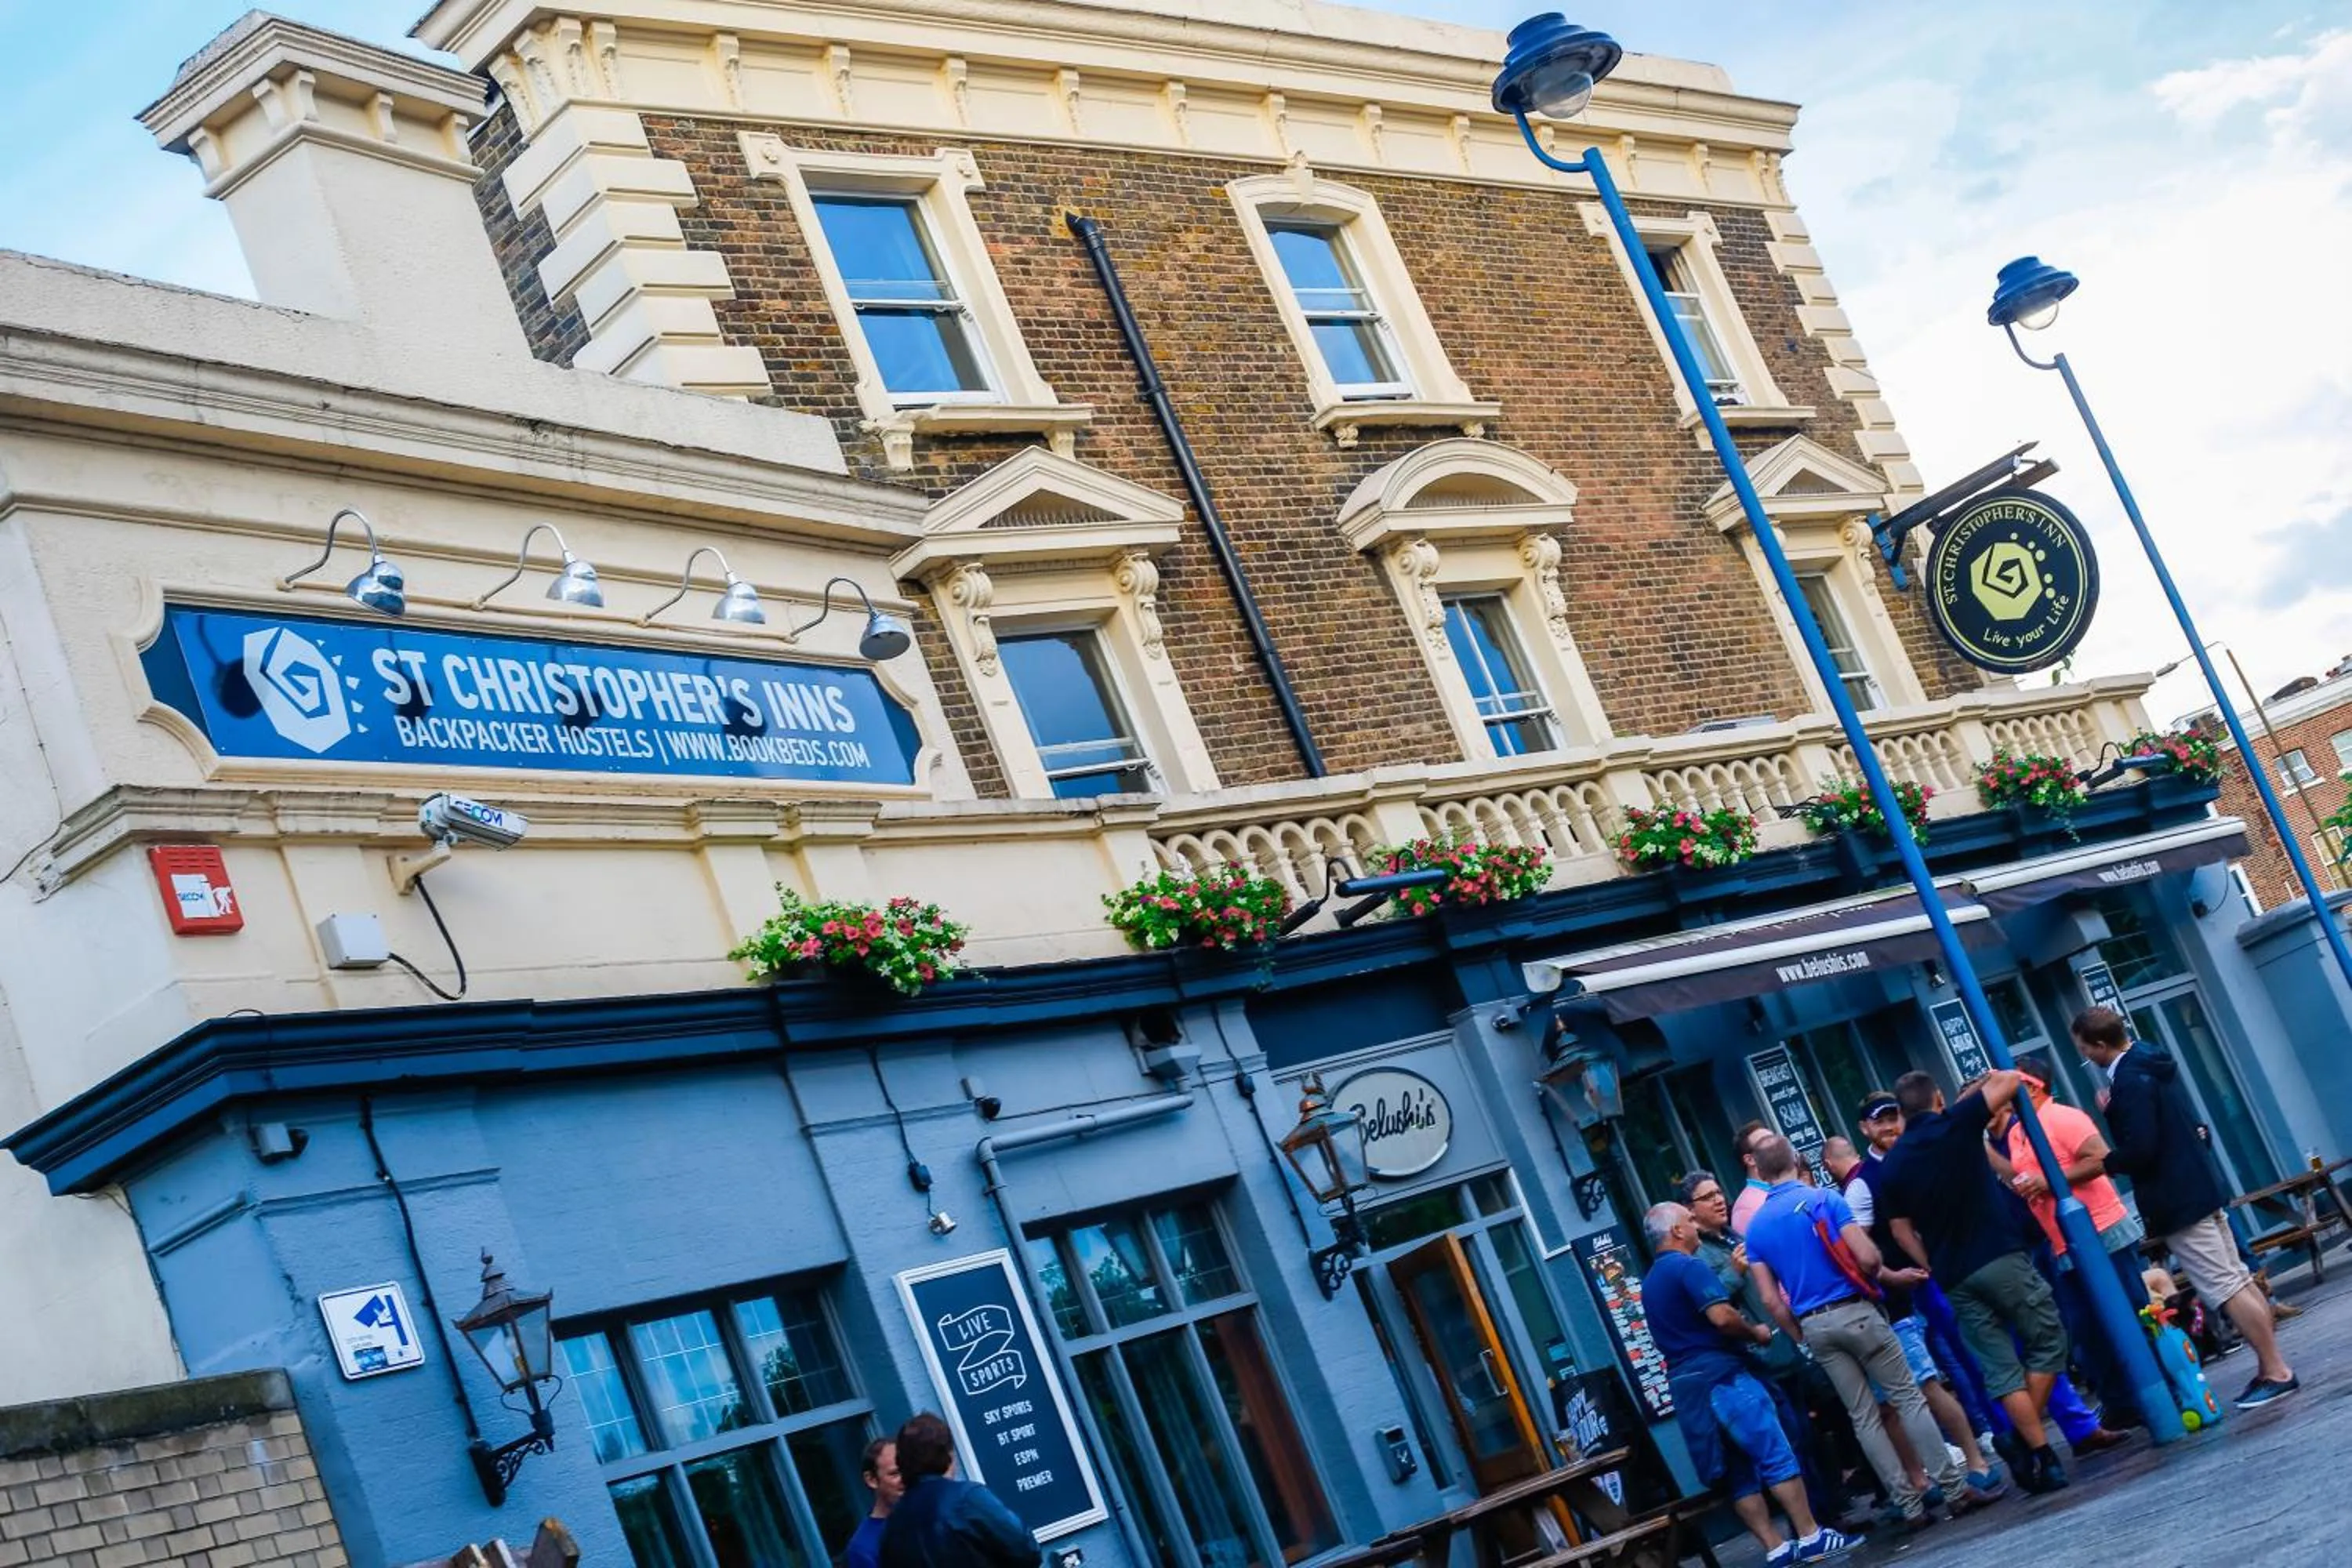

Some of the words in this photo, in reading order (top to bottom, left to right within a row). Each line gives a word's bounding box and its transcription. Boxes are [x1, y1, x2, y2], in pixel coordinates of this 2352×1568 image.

[1942, 506, 2038, 581] CHRISTOPHER'S
[2037, 516, 2067, 549] INN
[1983, 626, 2012, 648] Live
[2015, 623, 2047, 649] your
[2045, 593, 2071, 626] Life
[372, 648, 434, 707] ST
[441, 654, 764, 728] CHRISTOPHER'S
[761, 681, 856, 734] INNS
[394, 715, 555, 755] BACKPACKER
[554, 724, 655, 759] HOSTELS
[665, 730, 872, 769] WWW.BOOKBEDS.COM
[957, 1311, 992, 1341] LIVE
[970, 1356, 1014, 1388] SPORTS
[983, 1408, 1001, 1425] SKY
[1001, 1399, 1033, 1418] SPORTS
[996, 1431, 1011, 1446] BT
[1010, 1423, 1035, 1441] SPORT
[1013, 1448, 1040, 1466] ESPN
[1015, 1470, 1053, 1492] PREMIER
